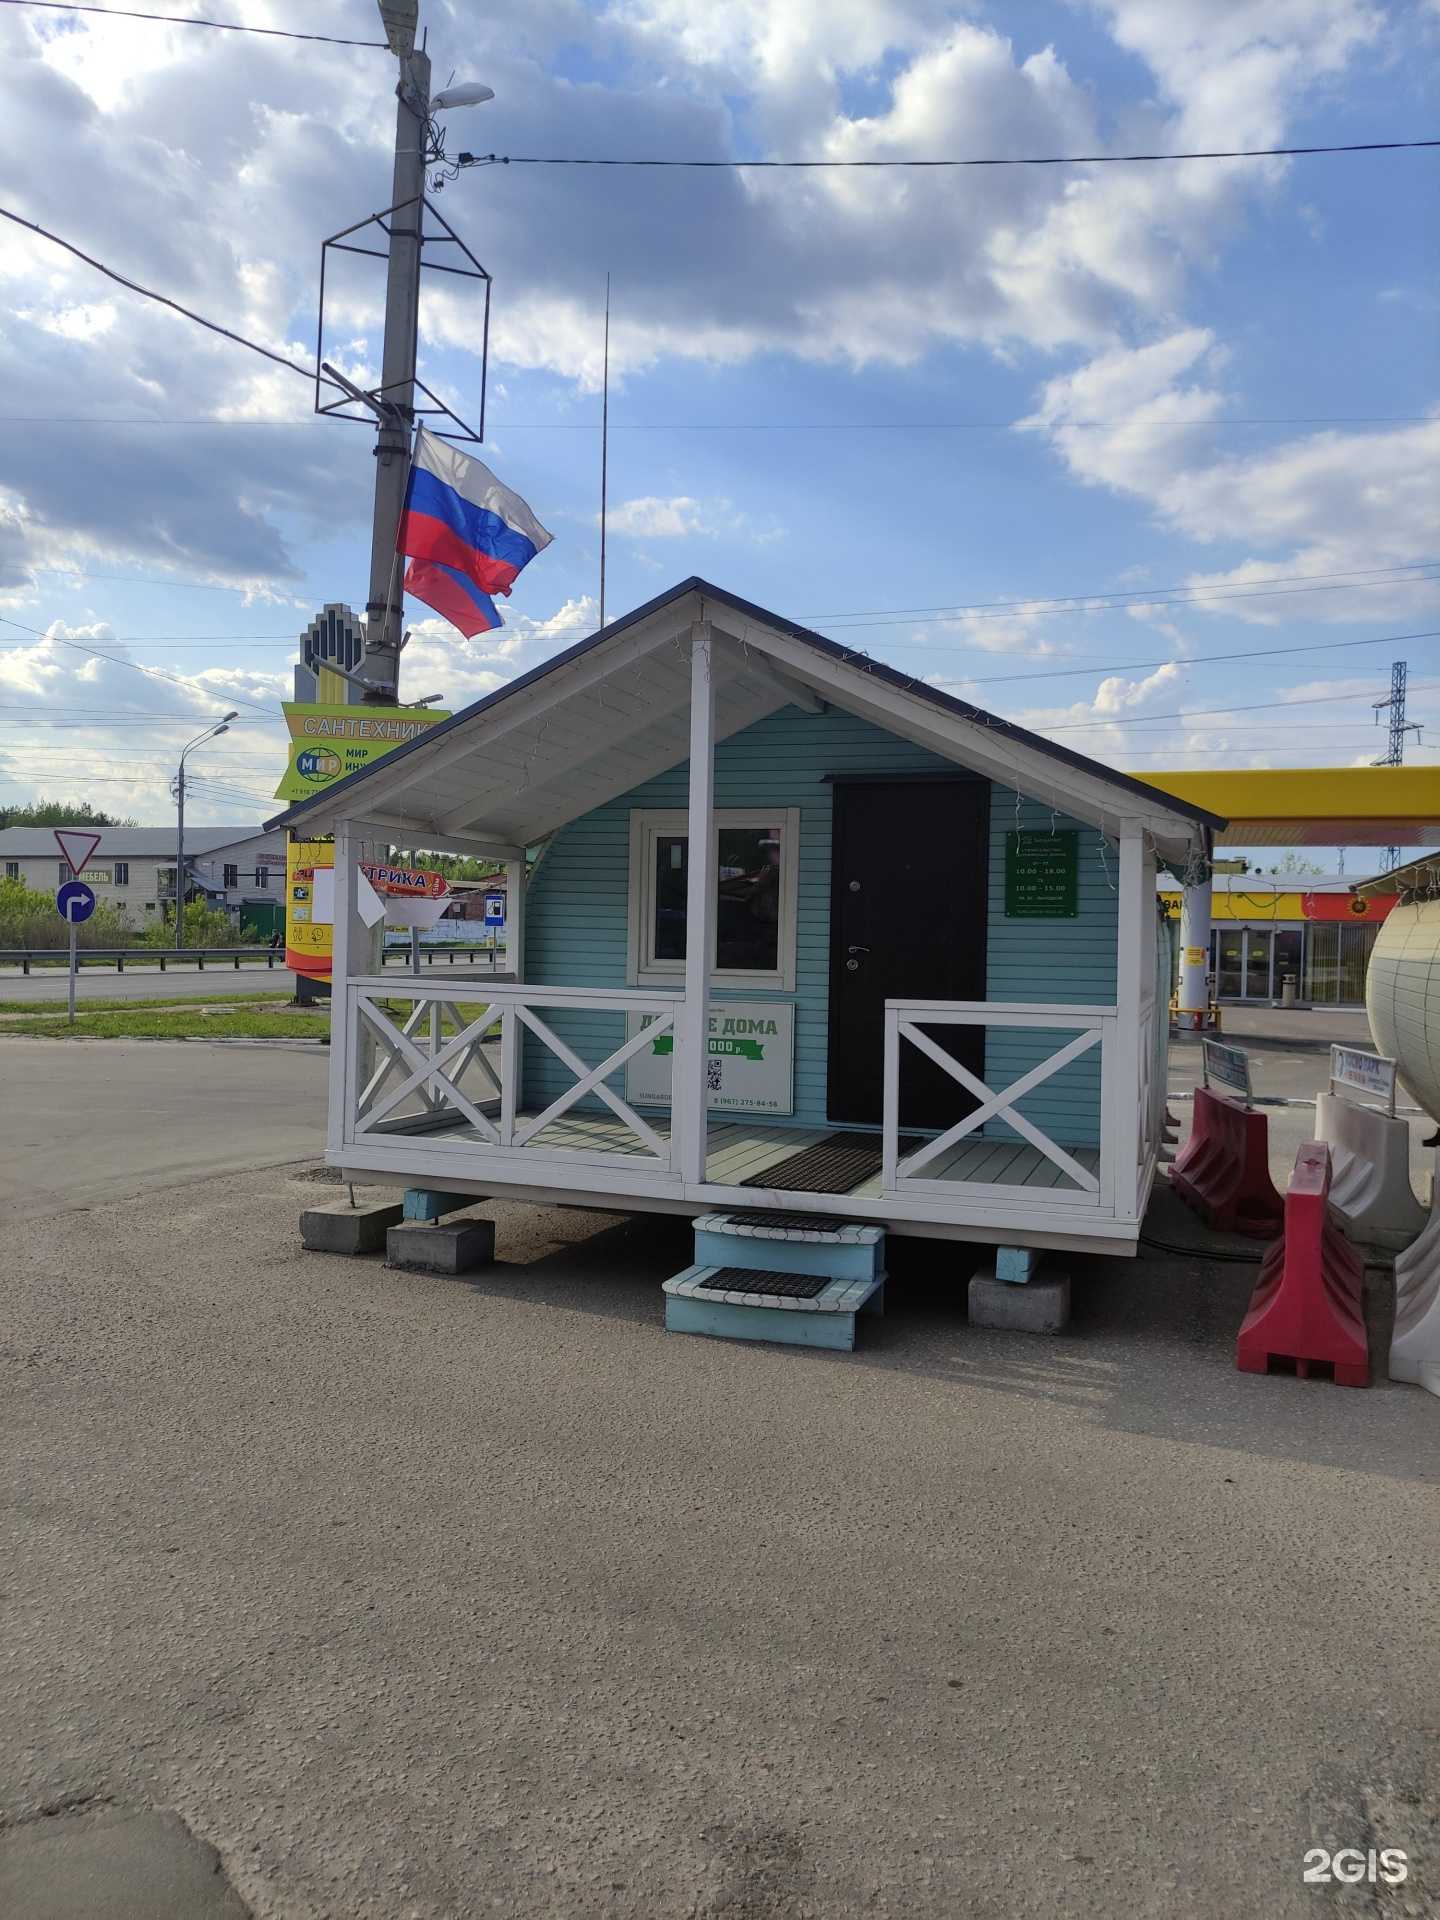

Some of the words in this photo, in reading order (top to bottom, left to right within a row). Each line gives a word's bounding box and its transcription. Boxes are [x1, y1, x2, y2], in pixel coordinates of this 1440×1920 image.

[346, 749, 368, 758] МИР
[301, 759, 337, 771] МИР
[722, 1018, 778, 1036] ДОМА
